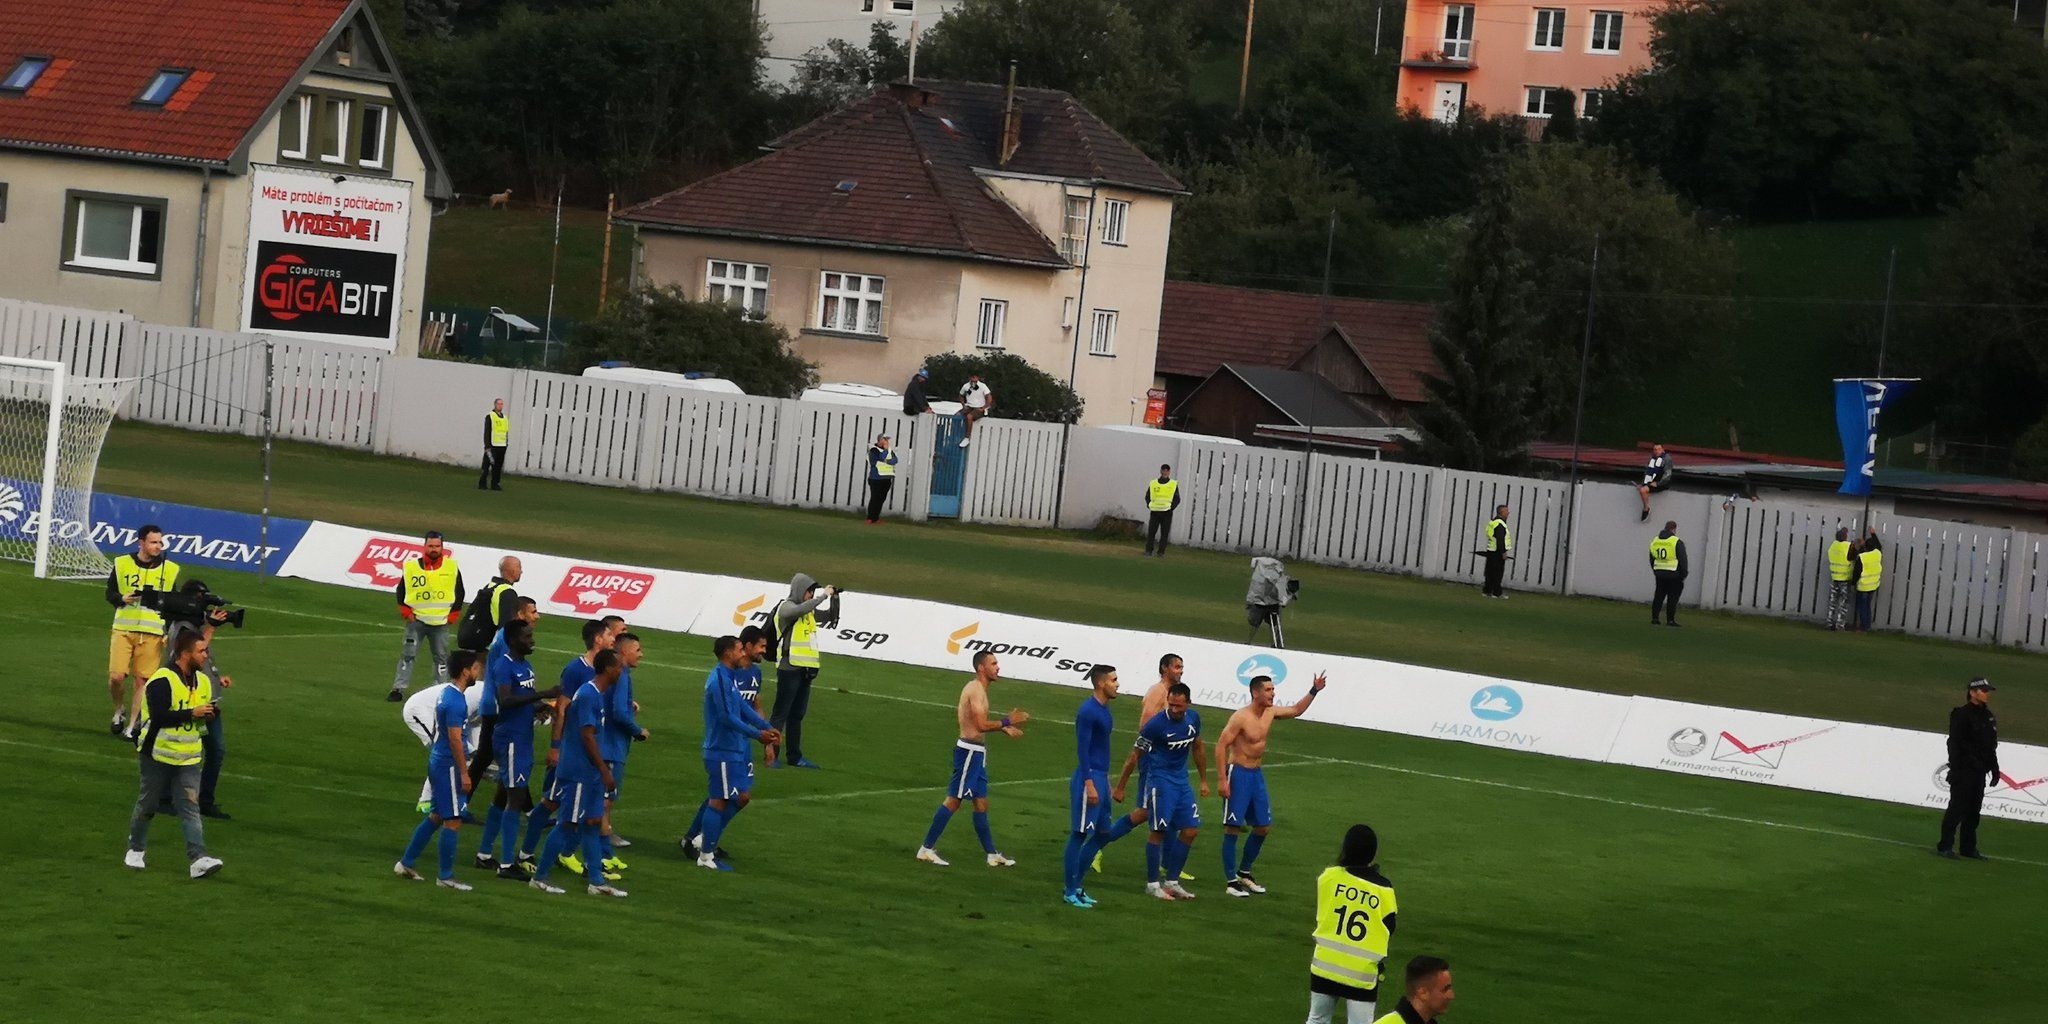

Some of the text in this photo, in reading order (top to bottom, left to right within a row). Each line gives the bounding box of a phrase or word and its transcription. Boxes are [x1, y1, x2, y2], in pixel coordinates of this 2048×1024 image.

[262, 186, 287, 201] Máte
[290, 190, 332, 206] problém
[334, 197, 341, 207] s
[343, 195, 394, 214] počítačom
[282, 210, 372, 242] VYRIEŠIME
[290, 265, 342, 279] COMPUTERS
[259, 264, 388, 317] GIGABIT
[84, 521, 280, 564] INVSTMENT
[366, 545, 423, 565] TAUR
[1656, 548, 1667, 560] 10
[124, 574, 140, 587] 12
[411, 575, 426, 588] 20
[568, 572, 645, 595] TAURIS
[837, 629, 889, 650] scp
[964, 639, 1060, 660] mondi
[1431, 721, 1541, 747] HARMONY
[1660, 758, 1775, 780] Harmanec-Kuvert
[1334, 883, 1380, 910] FOTO
[1333, 905, 1370, 942] 16
